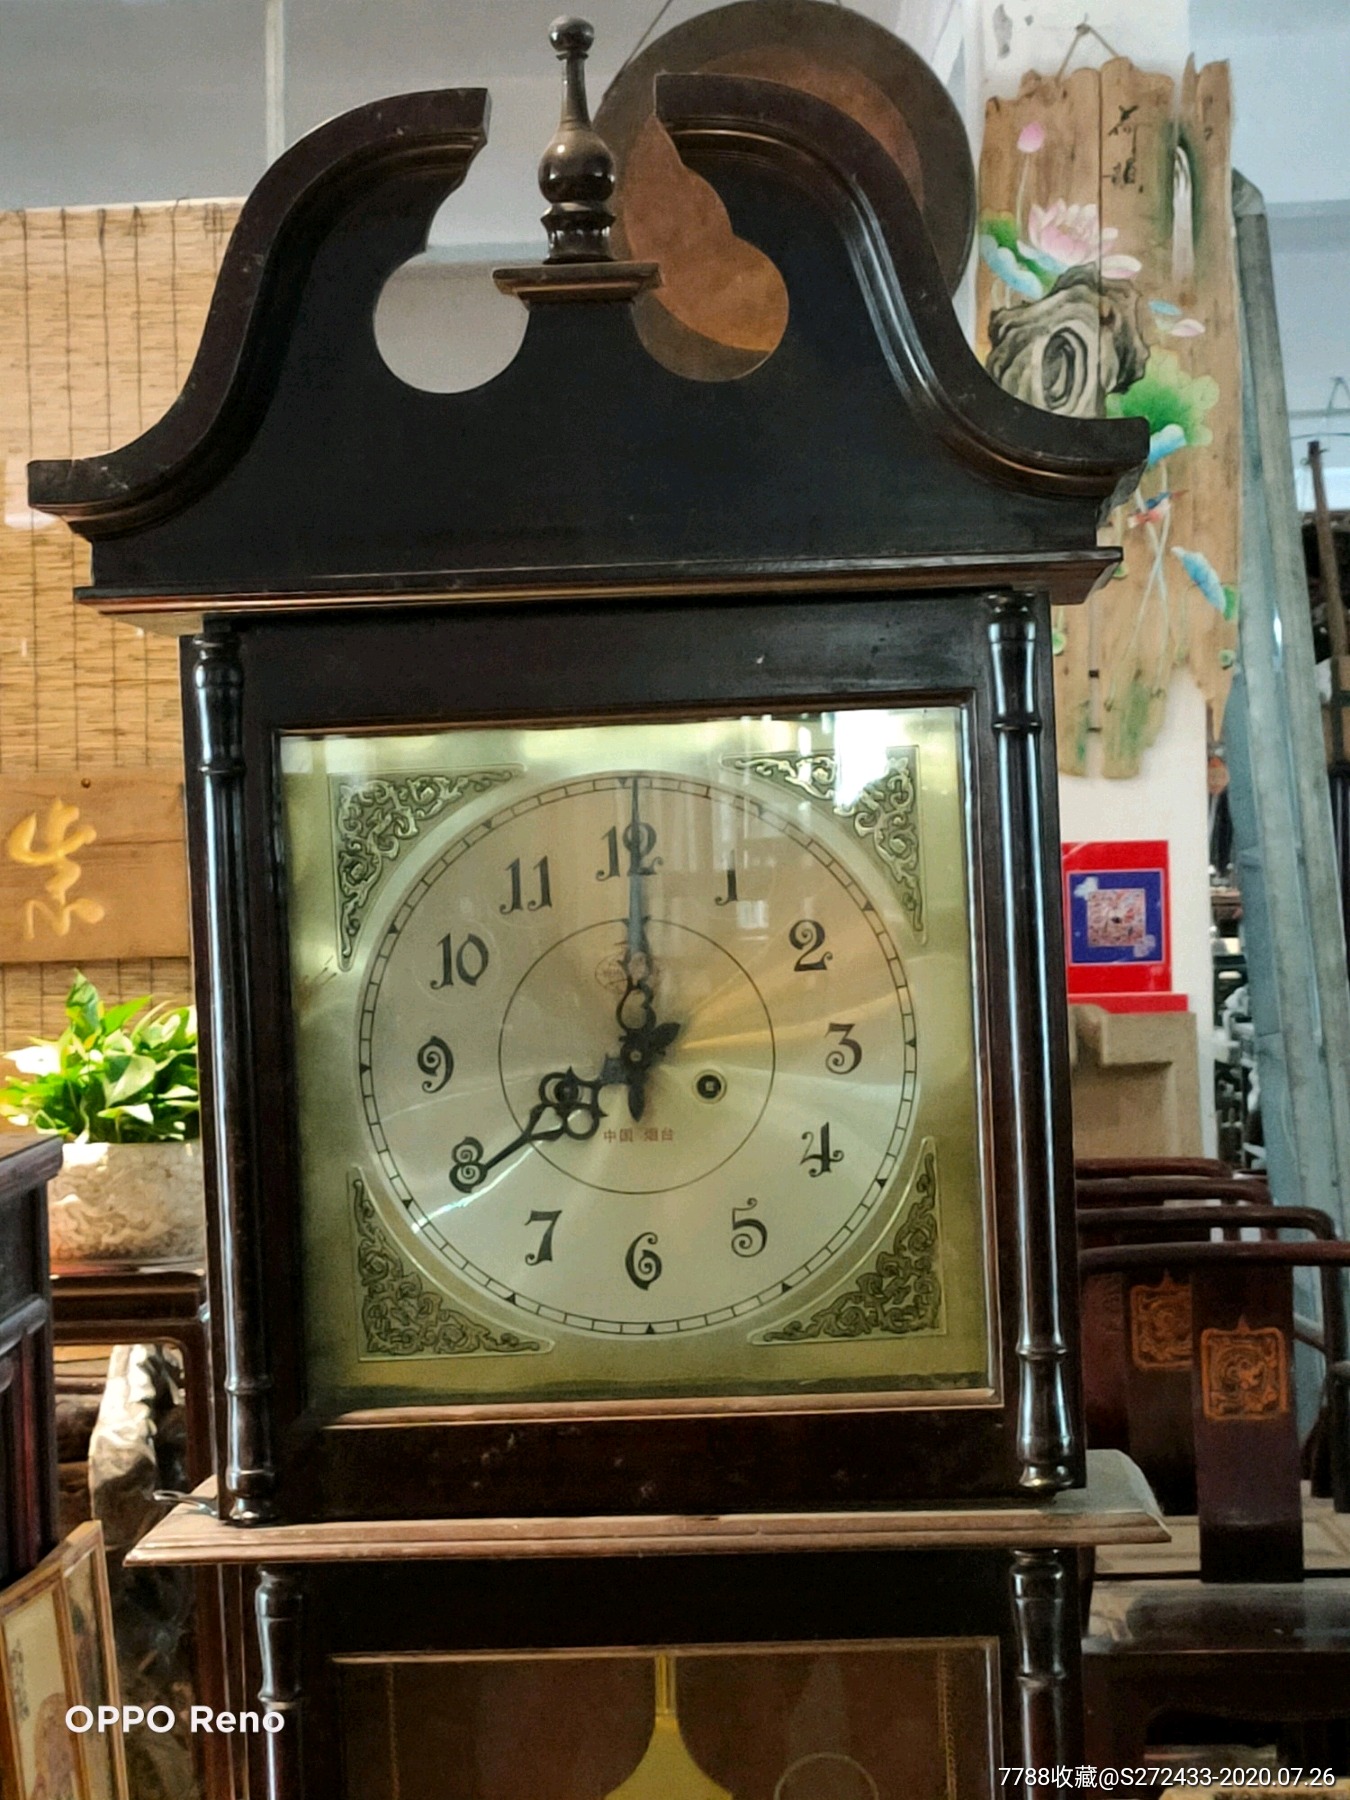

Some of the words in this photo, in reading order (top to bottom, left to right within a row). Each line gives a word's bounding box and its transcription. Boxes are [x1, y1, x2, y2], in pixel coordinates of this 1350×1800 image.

[595, 822, 664, 881] 12
[714, 848, 739, 906] 1
[500, 855, 553, 914] 11
[430, 932, 489, 989] 10
[788, 919, 833, 972] 2
[417, 1036, 454, 1092] 9
[824, 1023, 862, 1074] 3
[603, 1128, 633, 1143] 中国
[799, 1121, 845, 1178] 4
[449, 1136, 487, 1193] 8
[524, 1209, 563, 1266] 7
[730, 1197, 768, 1257] 5
[625, 1231, 663, 1291] 6
